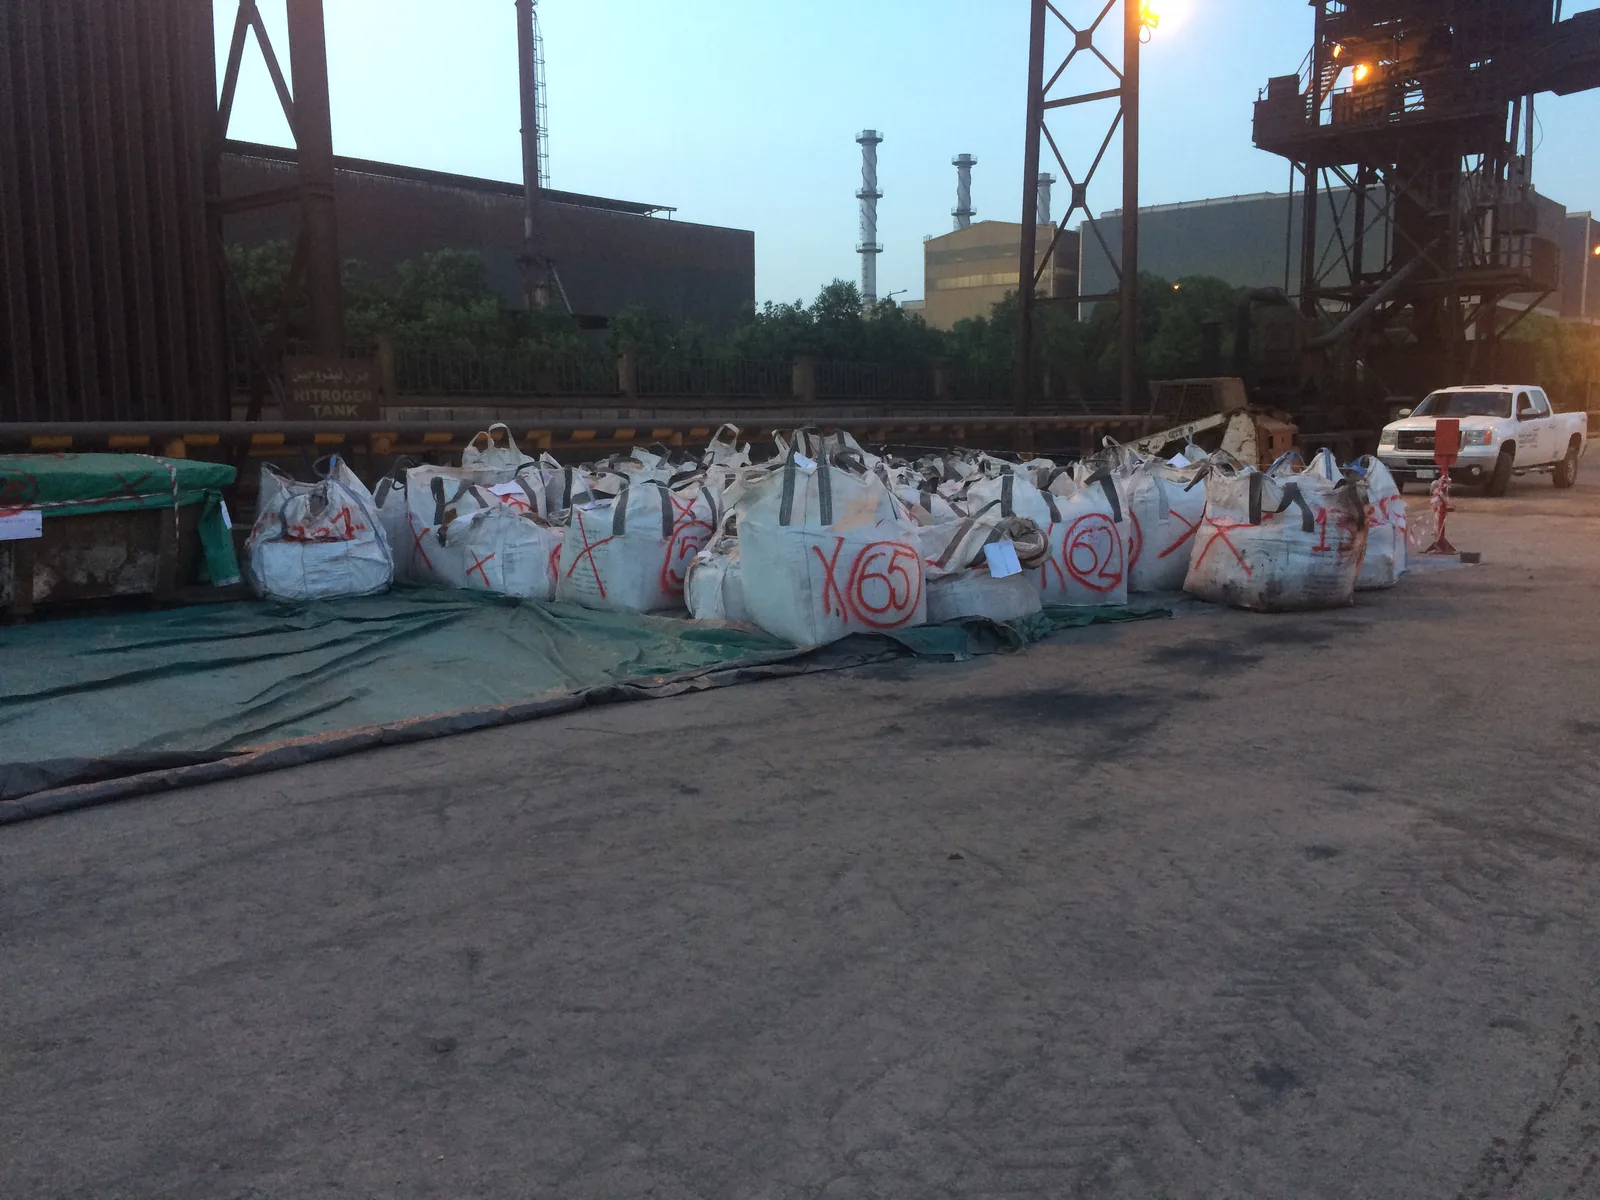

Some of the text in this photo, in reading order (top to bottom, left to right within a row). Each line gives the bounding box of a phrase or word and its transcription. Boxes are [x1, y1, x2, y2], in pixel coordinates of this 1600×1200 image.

[293, 389, 372, 402] NITROGEN
[310, 404, 358, 420] TANK
[855, 547, 917, 614] 65
